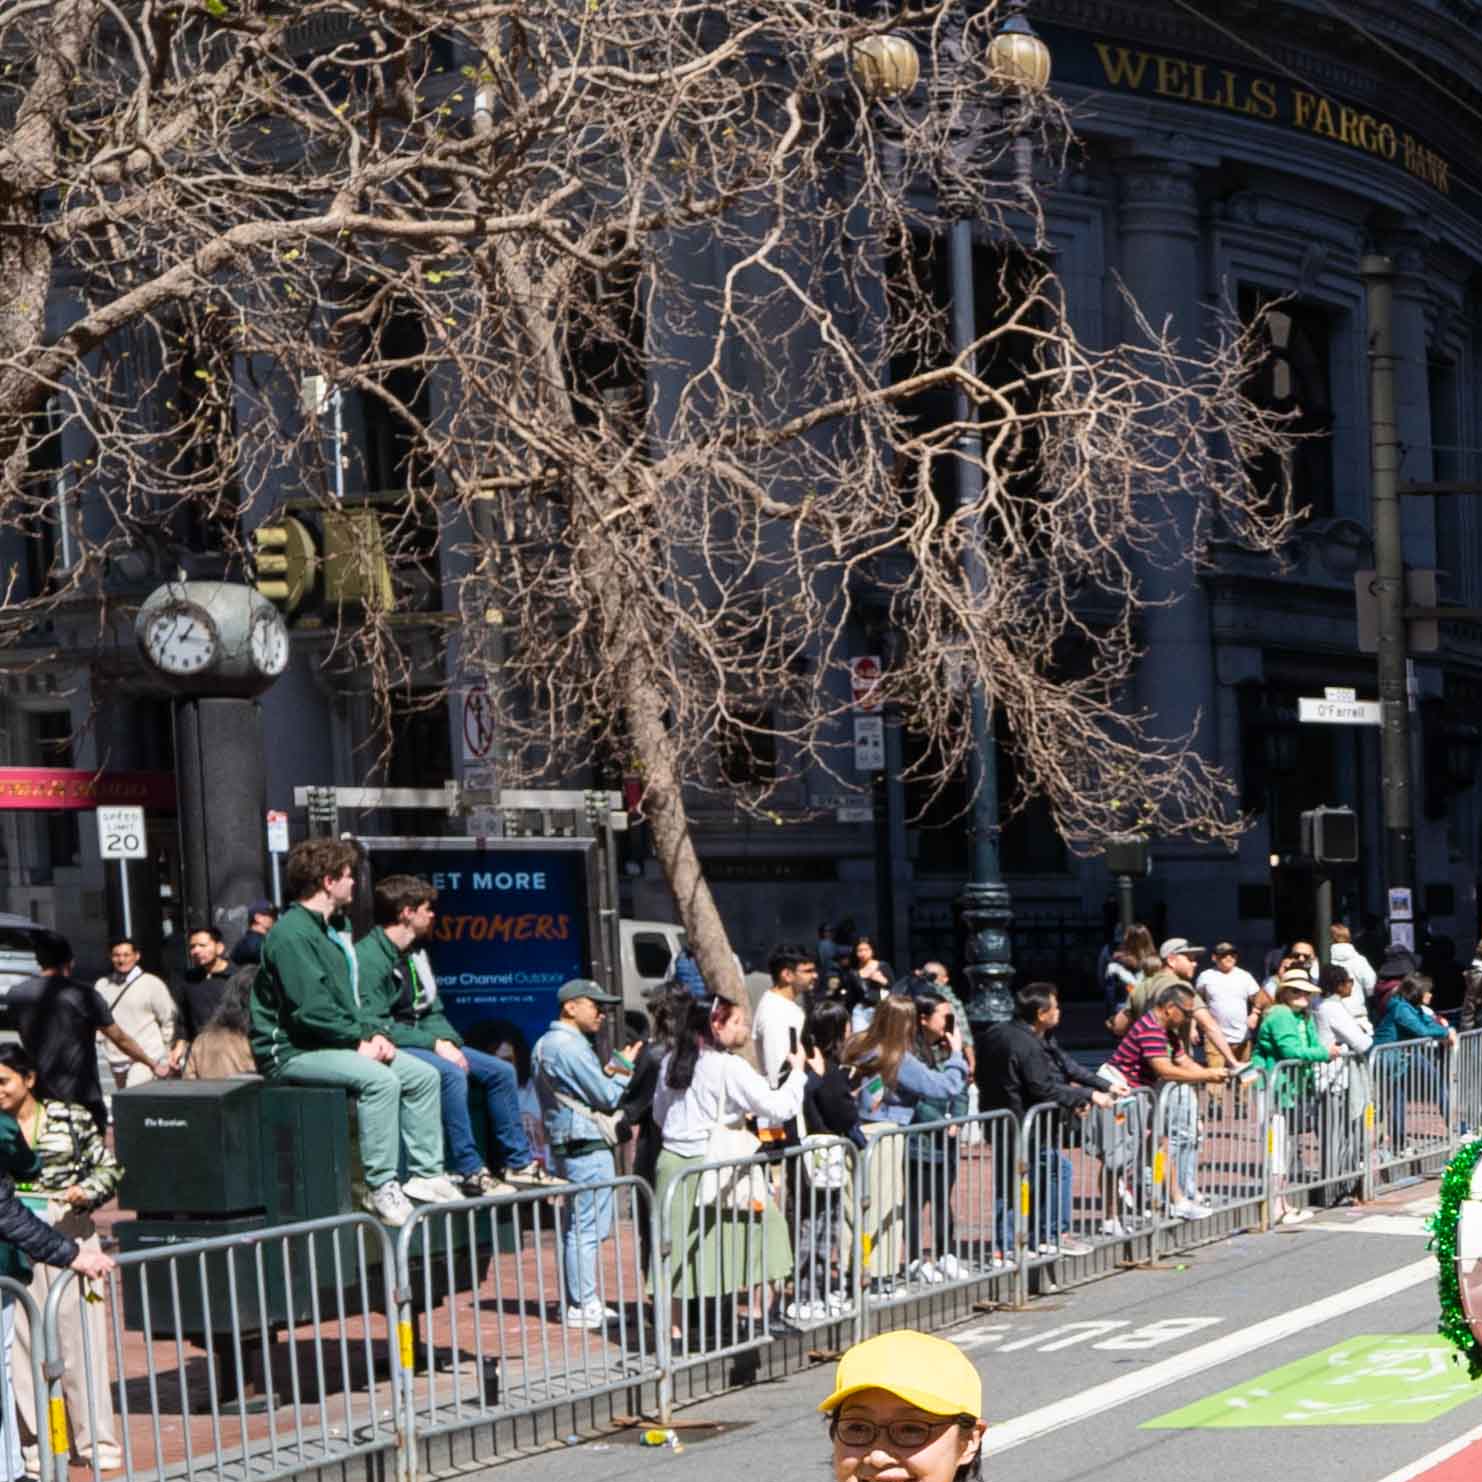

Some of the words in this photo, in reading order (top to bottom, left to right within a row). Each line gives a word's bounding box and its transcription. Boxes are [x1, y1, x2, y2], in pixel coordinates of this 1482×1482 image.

[1093, 40, 1279, 120] WELLS
[1290, 87, 1398, 161] FARGO
[1402, 133, 1450, 194] BANK
[1317, 703, 1365, 718] O'Farrell
[103, 812, 138, 821] SPEED
[106, 834, 139, 851] 20
[431, 871, 463, 890] ET
[473, 872, 547, 890] MORE
[434, 913, 571, 942] STOMERS
[460, 972, 513, 985] Channel
[515, 972, 564, 984] Outdoor
